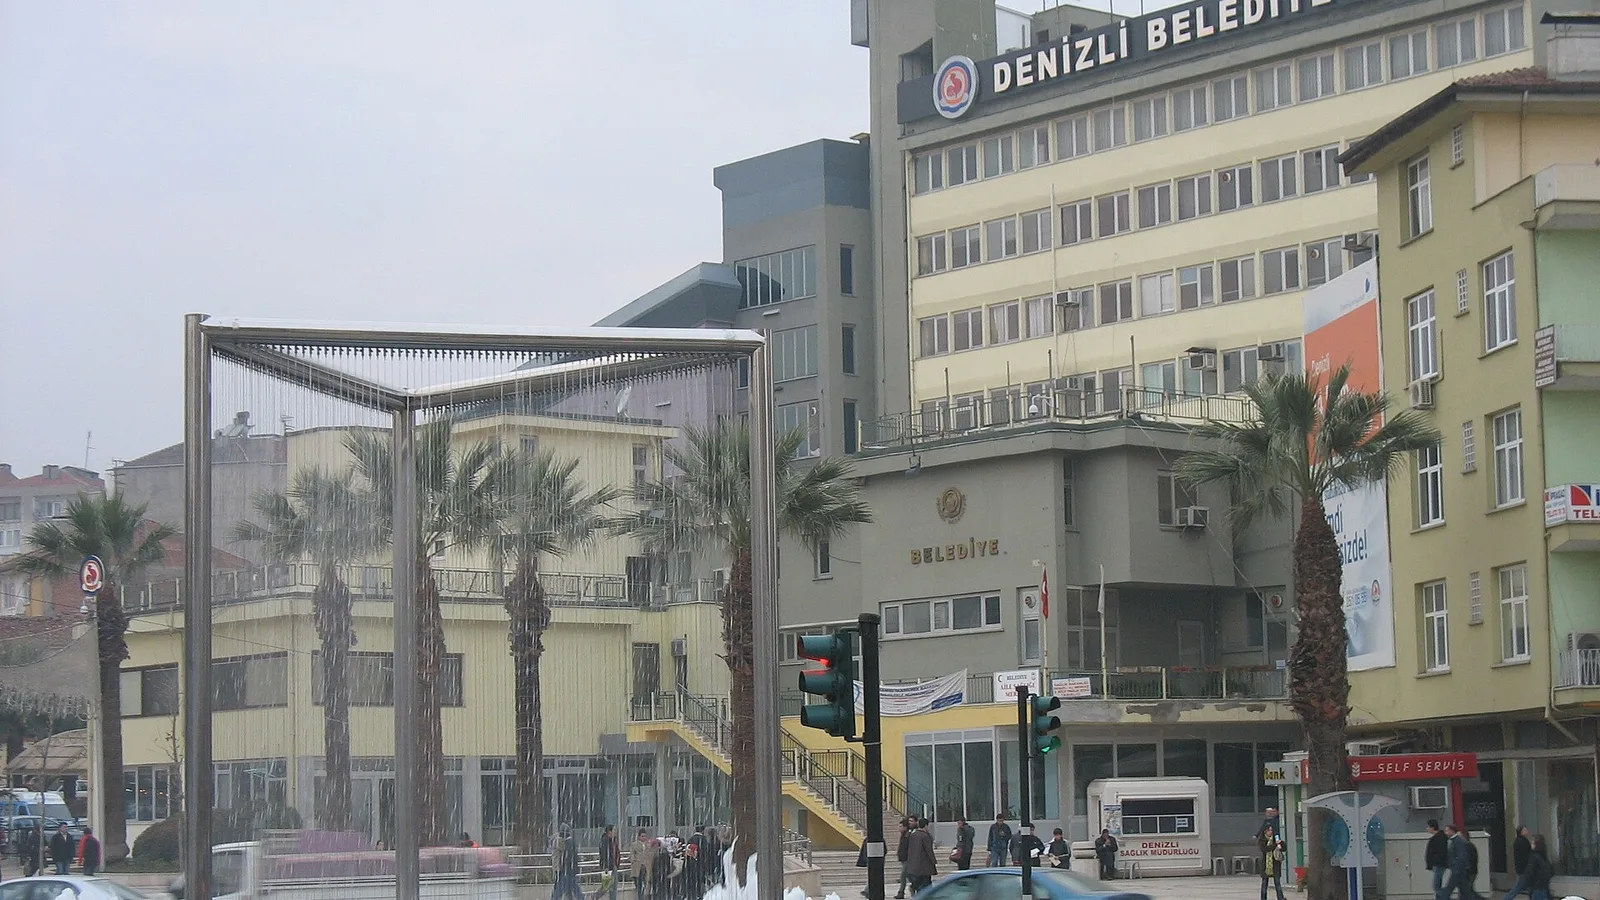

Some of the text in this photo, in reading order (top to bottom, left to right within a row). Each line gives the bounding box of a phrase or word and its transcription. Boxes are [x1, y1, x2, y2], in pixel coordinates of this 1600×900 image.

[993, 0, 1331, 93] DENİZLİ BELED
[910, 536, 999, 565] BELEDİYE
[1378, 759, 1465, 773] SELF SERVİS
[1141, 841, 1180, 849] DENİZLİ
